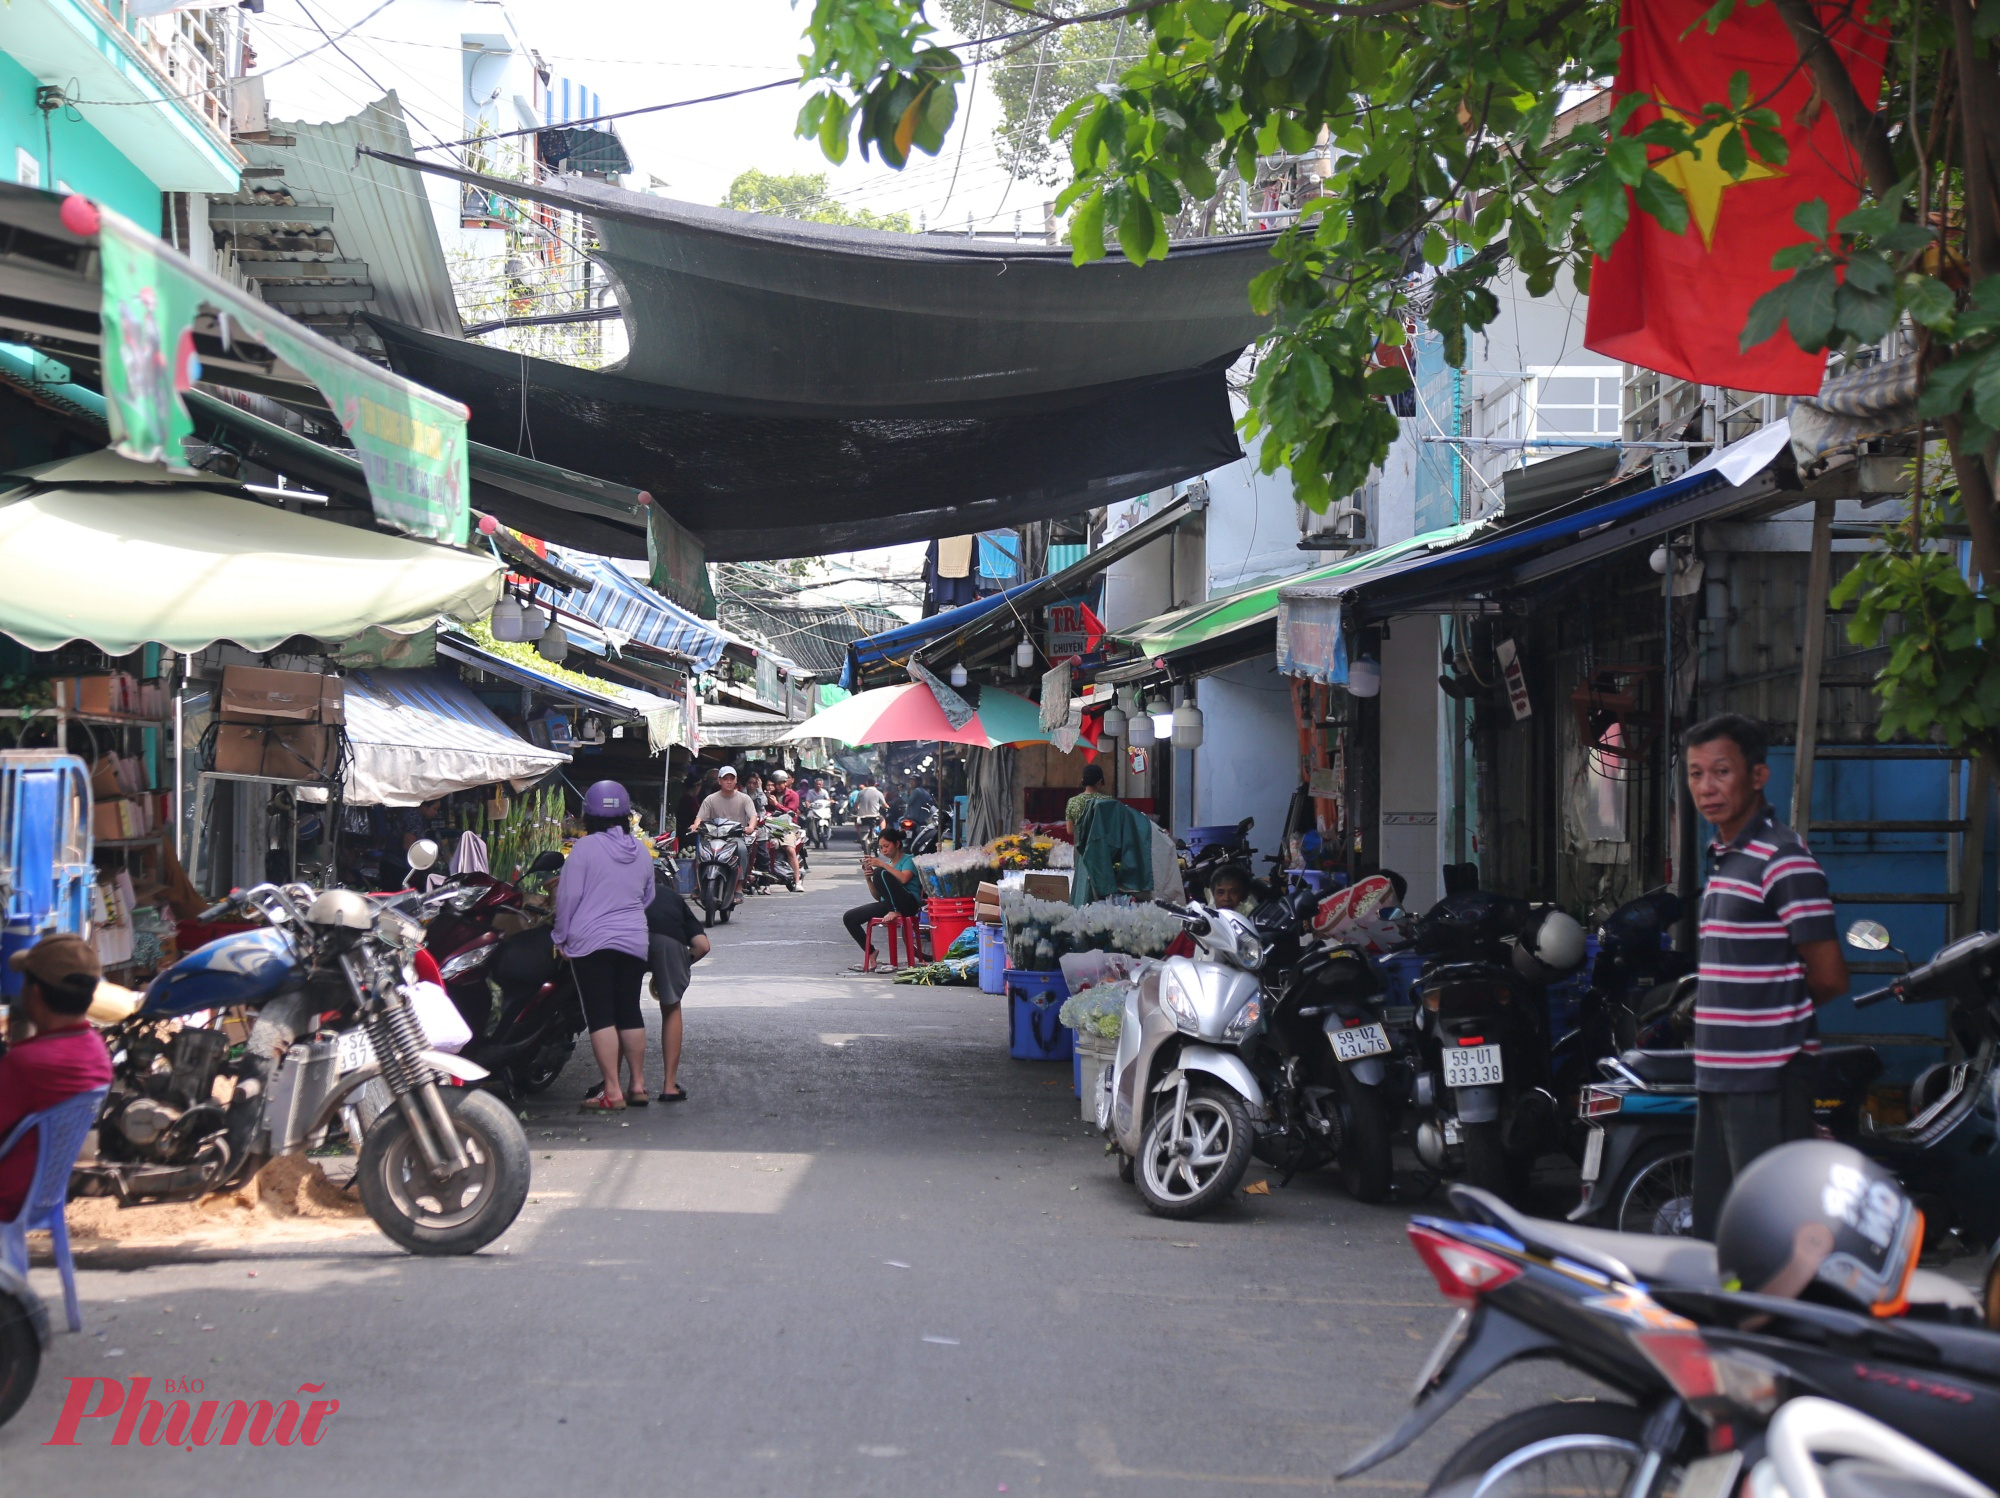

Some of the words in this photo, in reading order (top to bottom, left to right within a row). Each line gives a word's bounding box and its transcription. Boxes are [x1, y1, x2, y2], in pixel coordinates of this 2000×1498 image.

[1337, 1026, 1378, 1045] 59-U2
[1340, 1039, 1386, 1059] 434.76
[1452, 1049, 1492, 1067] 59-U1
[1449, 1065, 1500, 1084] 333.38
